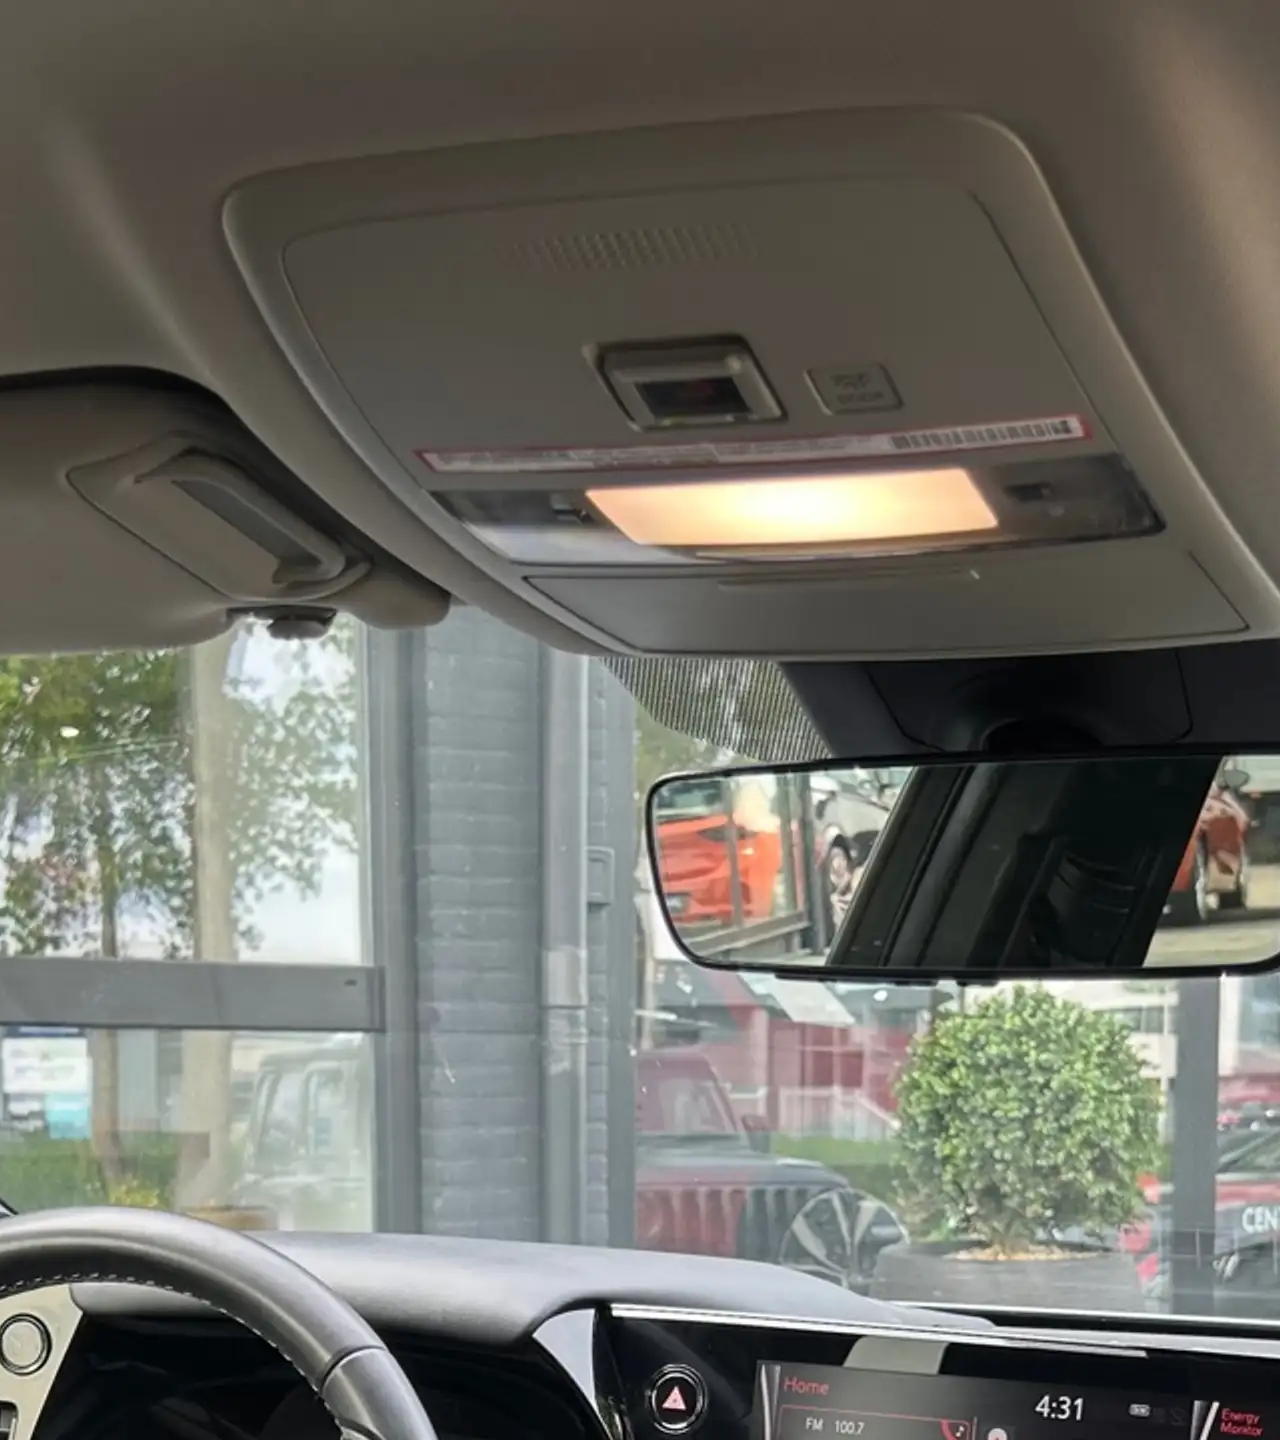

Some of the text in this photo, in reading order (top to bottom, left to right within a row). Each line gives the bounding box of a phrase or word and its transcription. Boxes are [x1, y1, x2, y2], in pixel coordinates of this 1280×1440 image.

[784, 1377, 830, 1395] Home
[1035, 1395, 1084, 1421] 4:31
[1221, 1408, 1260, 1424] Energy
[806, 1417, 865, 1435] FM 100.7
[1220, 1422, 1263, 1437] Monitor
